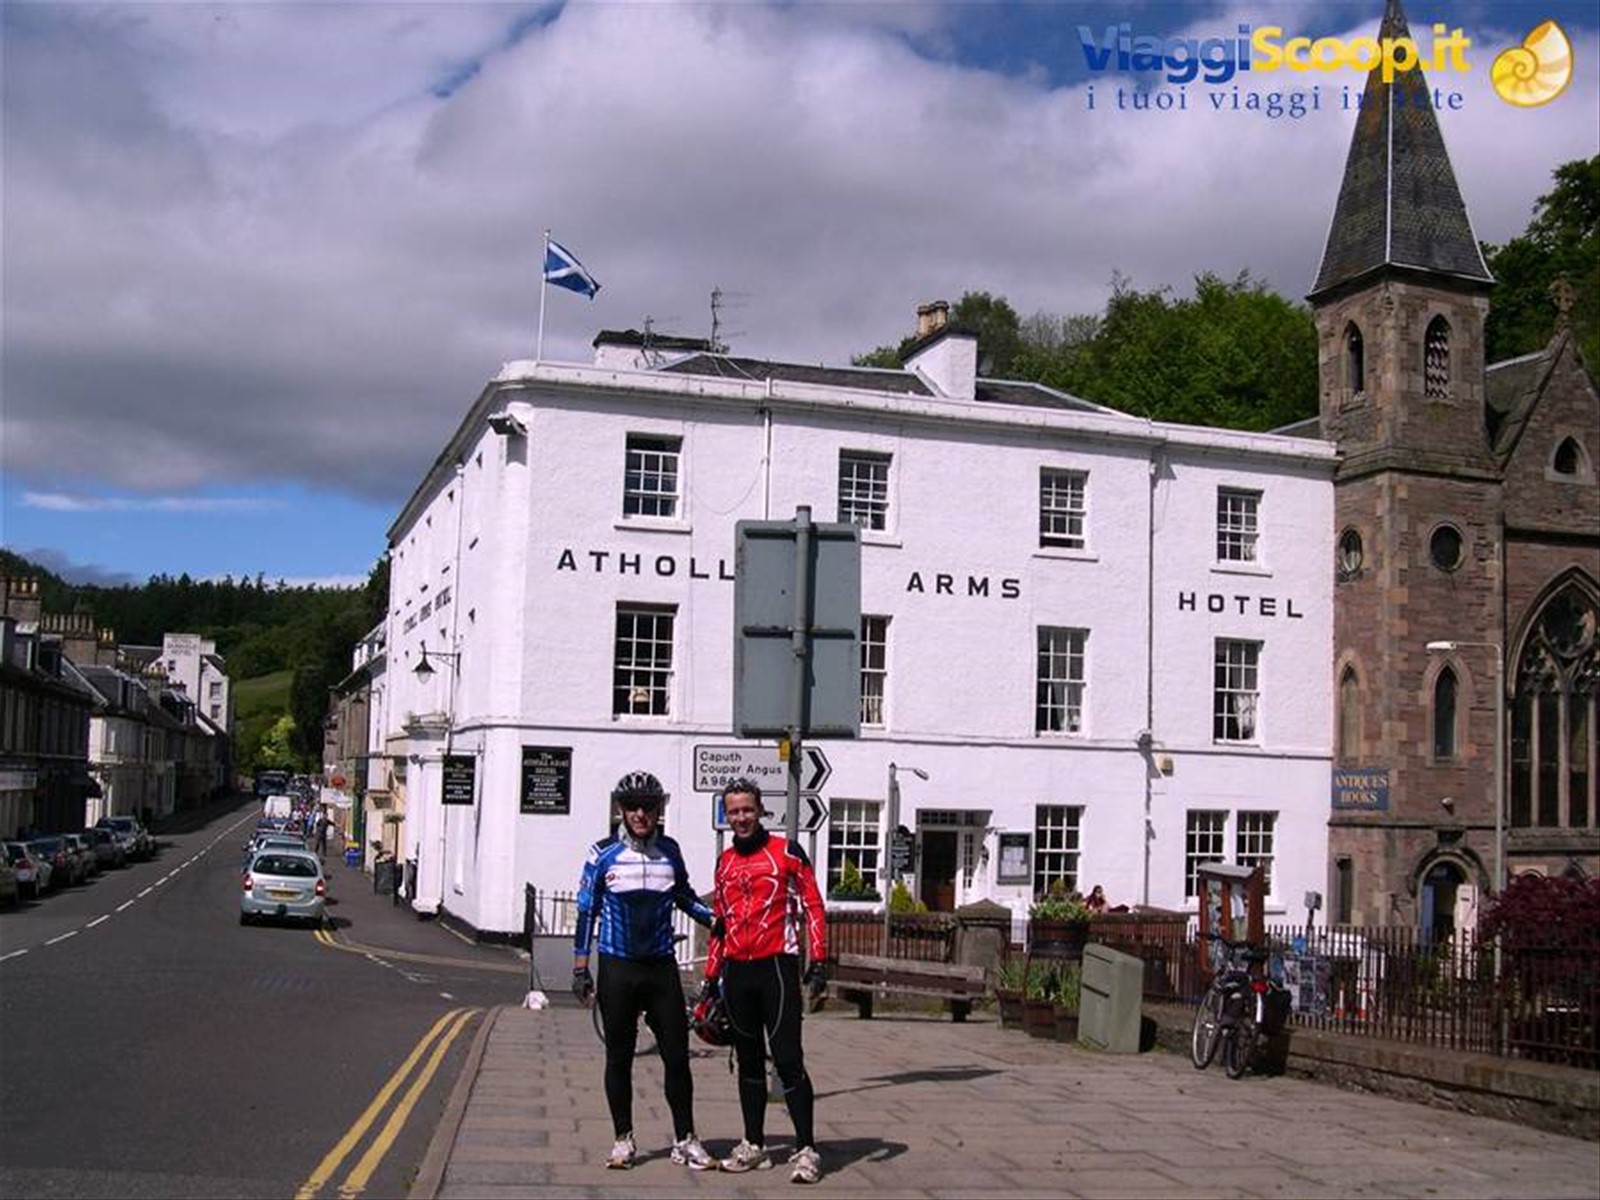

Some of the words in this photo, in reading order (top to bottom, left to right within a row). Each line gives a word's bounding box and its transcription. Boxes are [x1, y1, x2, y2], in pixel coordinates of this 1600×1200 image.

[557, 549, 735, 580] ATHOLL
[906, 571, 1021, 599] ARMS
[1178, 591, 1304, 619] HOTEL
[700, 750, 742, 762] Caputh
[700, 763, 741, 774] Coupar
[746, 764, 782, 775] Angus
